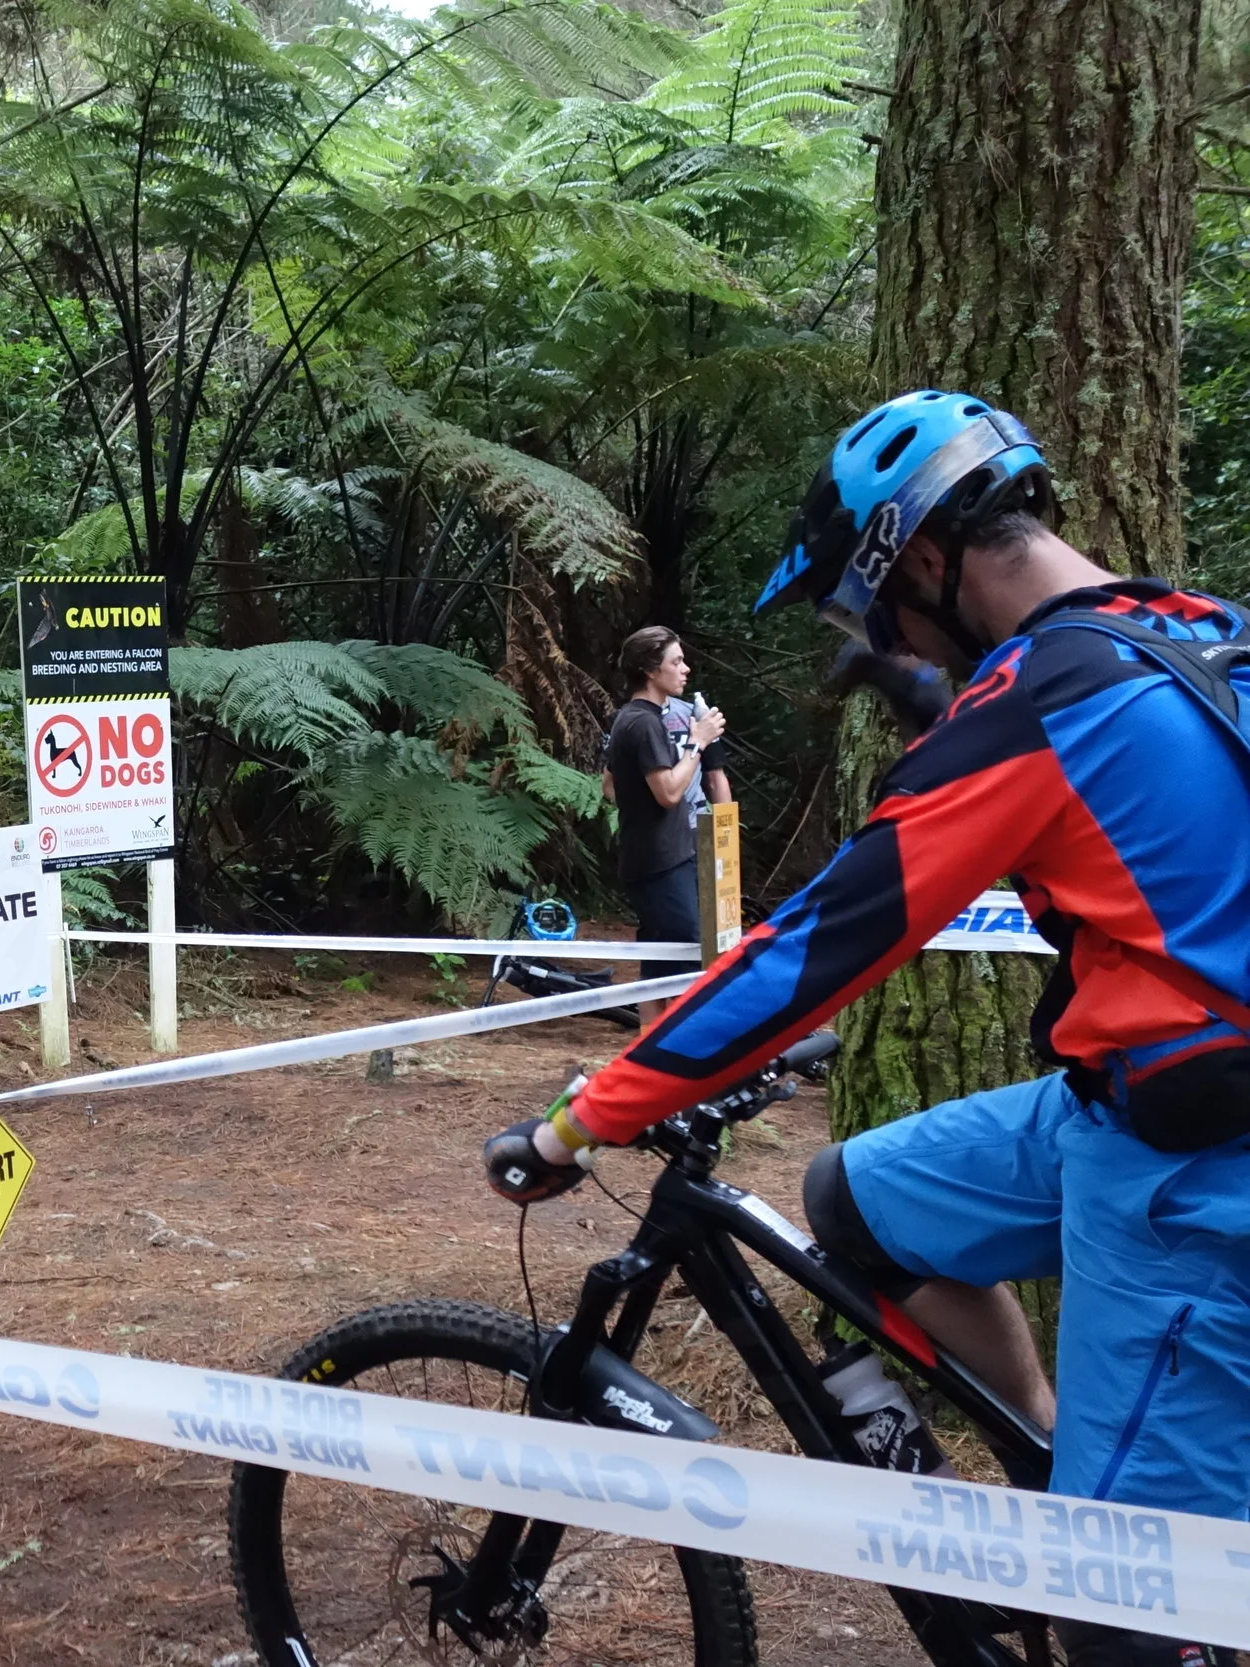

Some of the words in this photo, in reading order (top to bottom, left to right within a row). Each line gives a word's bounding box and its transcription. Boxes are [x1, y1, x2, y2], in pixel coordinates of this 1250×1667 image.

[66, 607, 161, 628] CAUTION
[50, 651, 68, 661] YOU
[69, 650, 84, 660] ARE
[86, 649, 124, 660] ENTERING
[125, 650, 131, 658] A
[132, 648, 162, 658] FALCON
[32, 664, 77, 676] BREEDING
[78, 663, 99, 674] AND
[100, 662, 138, 673] NESTING
[139, 661, 162, 672] AREA
[98, 713, 164, 760] NO
[100, 760, 165, 789] DOGS
[85, 799, 132, 812] SIDEWINDER
[134, 798, 140, 807] &
[64, 836, 111, 849] TIMBERLANDS
